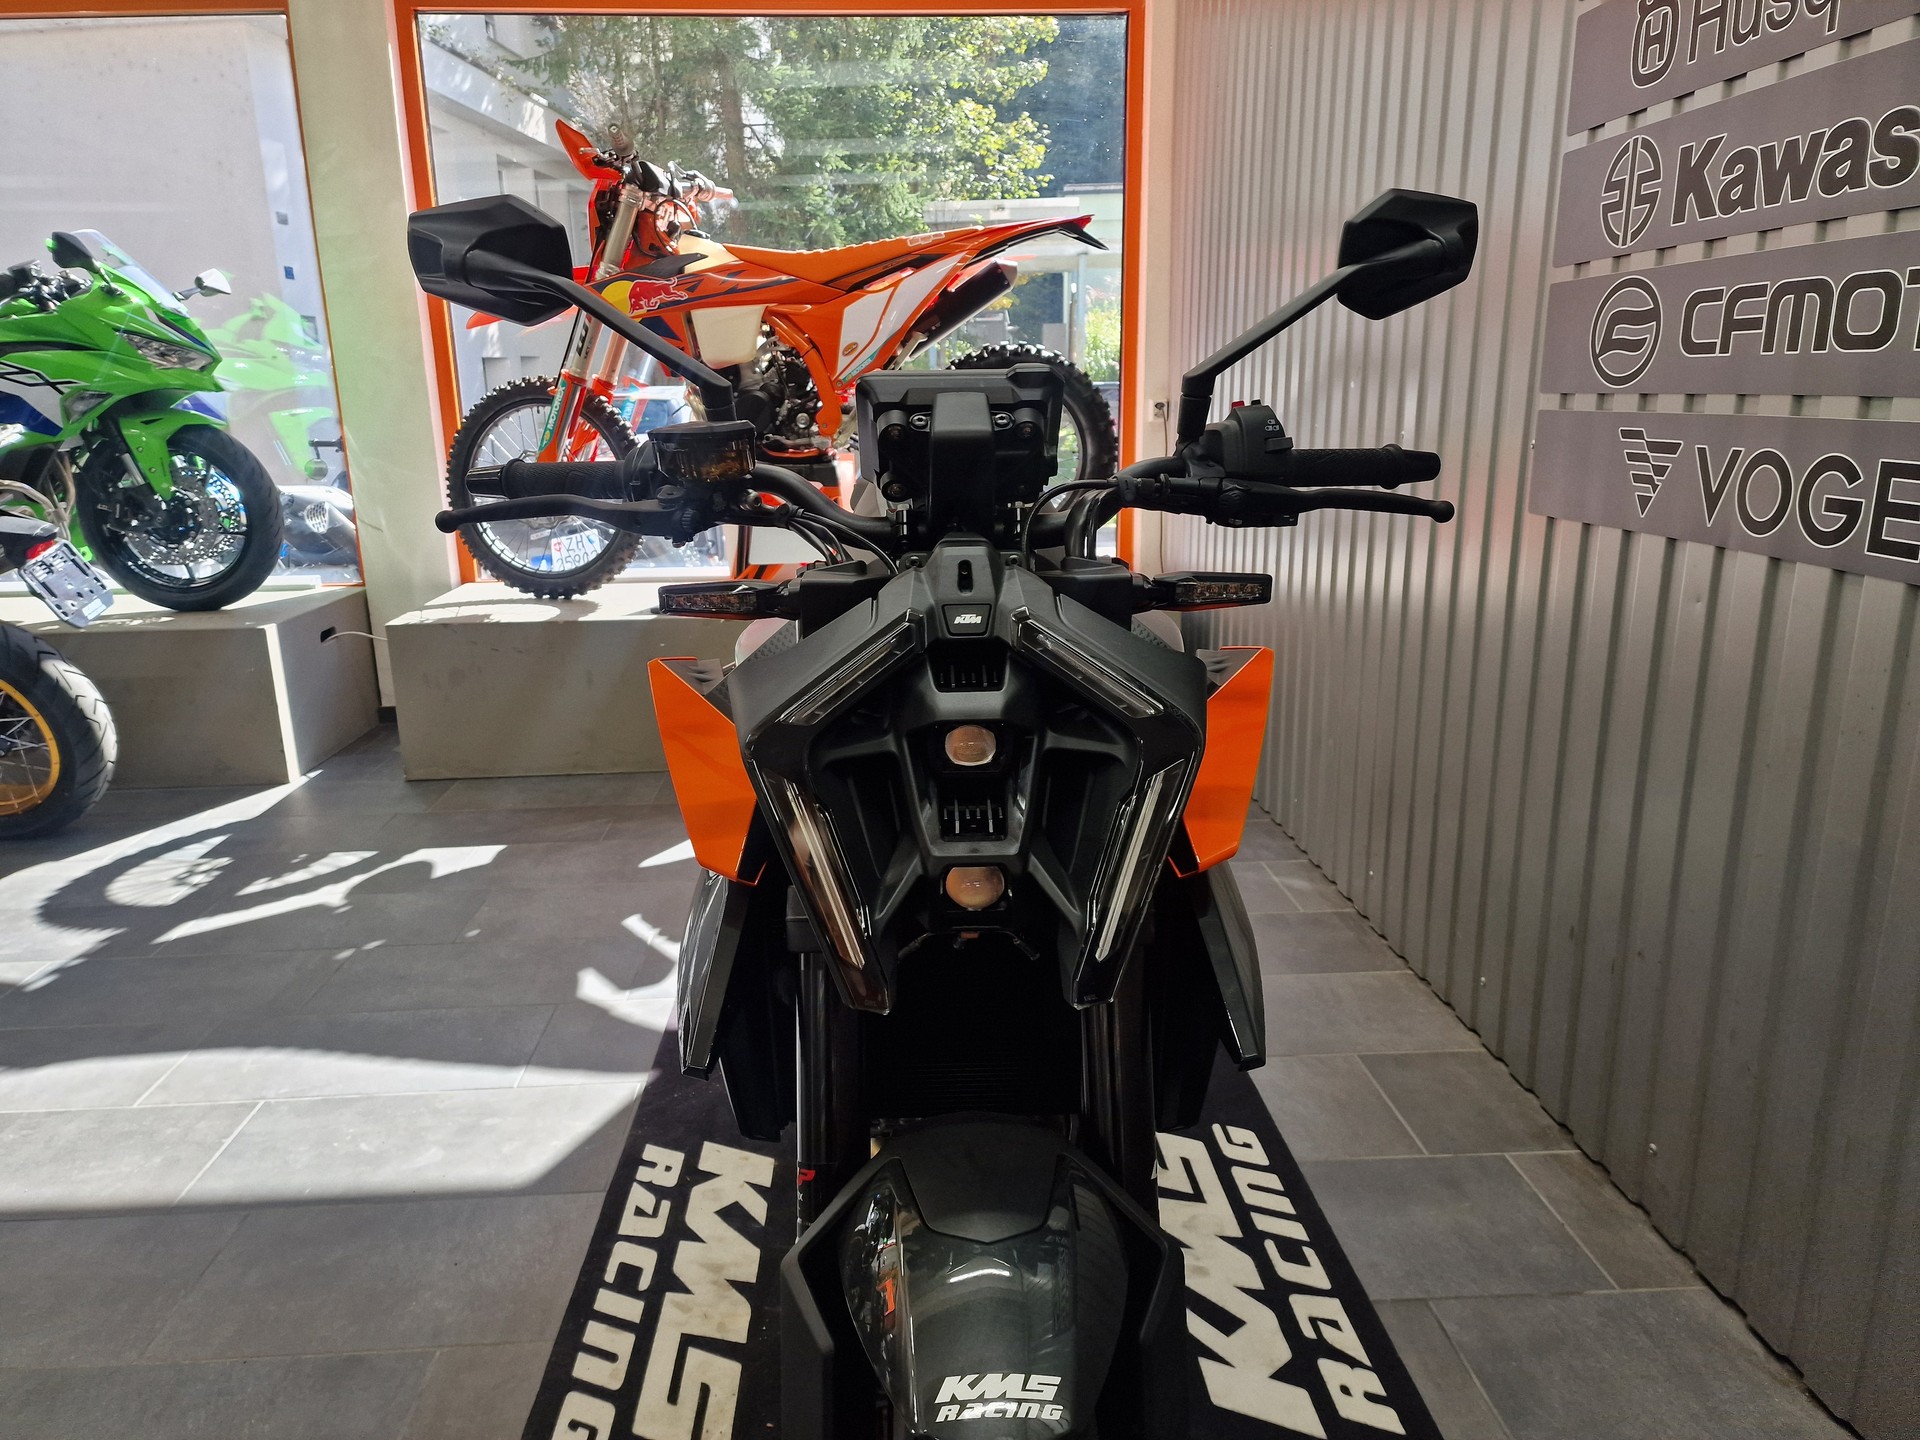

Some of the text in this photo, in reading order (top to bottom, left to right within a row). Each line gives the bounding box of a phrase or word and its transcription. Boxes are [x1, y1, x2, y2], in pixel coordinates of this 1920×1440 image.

[1671, 105, 1920, 227] Kawas
[1679, 266, 1920, 358] CFMO
[547, 386, 566, 430] MOTOREX
[1694, 445, 1920, 564] VOGE
[953, 613, 983, 625] KTM
[632, 1140, 775, 1440] KMS
[1151, 1131, 1328, 1440] KMS
[934, 1373, 1062, 1404] KMS
